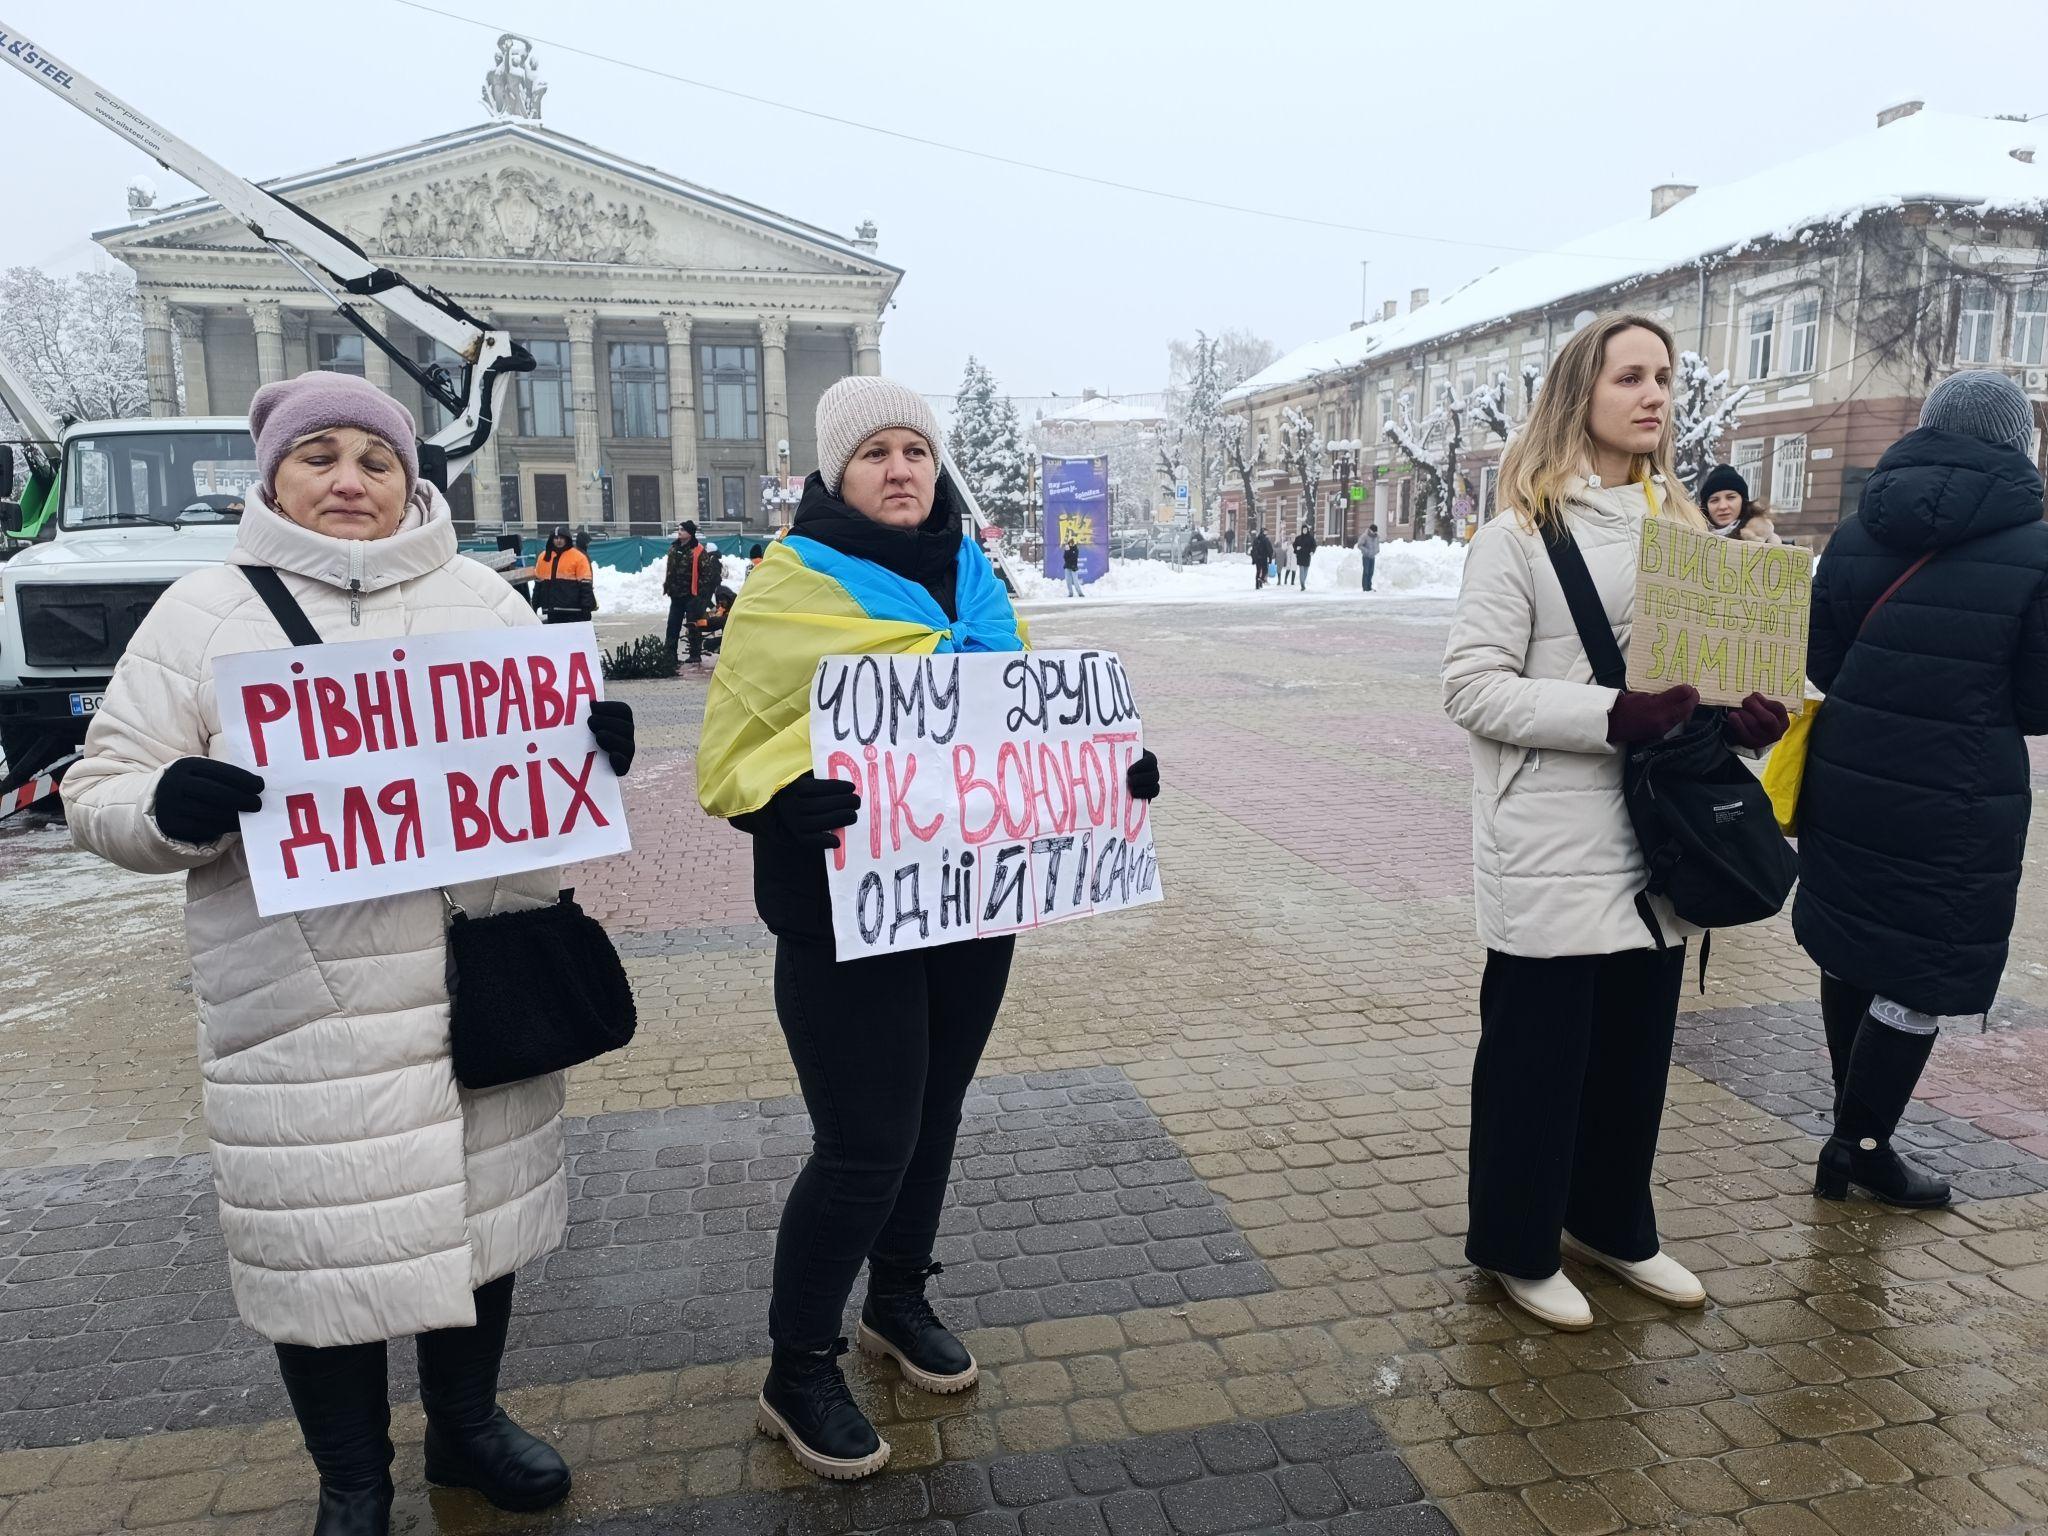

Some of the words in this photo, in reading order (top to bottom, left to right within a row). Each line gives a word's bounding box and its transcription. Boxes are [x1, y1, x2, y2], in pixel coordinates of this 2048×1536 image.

[94, 91, 151, 130] scorpion
[95, 106, 161, 152] www.oilsteel.com
[428, 651, 597, 743] ПРАВА
[817, 654, 960, 746] ЧОМУ
[1003, 651, 1141, 733] ДРУГИЙ
[279, 778, 425, 879] ДЛЯ
